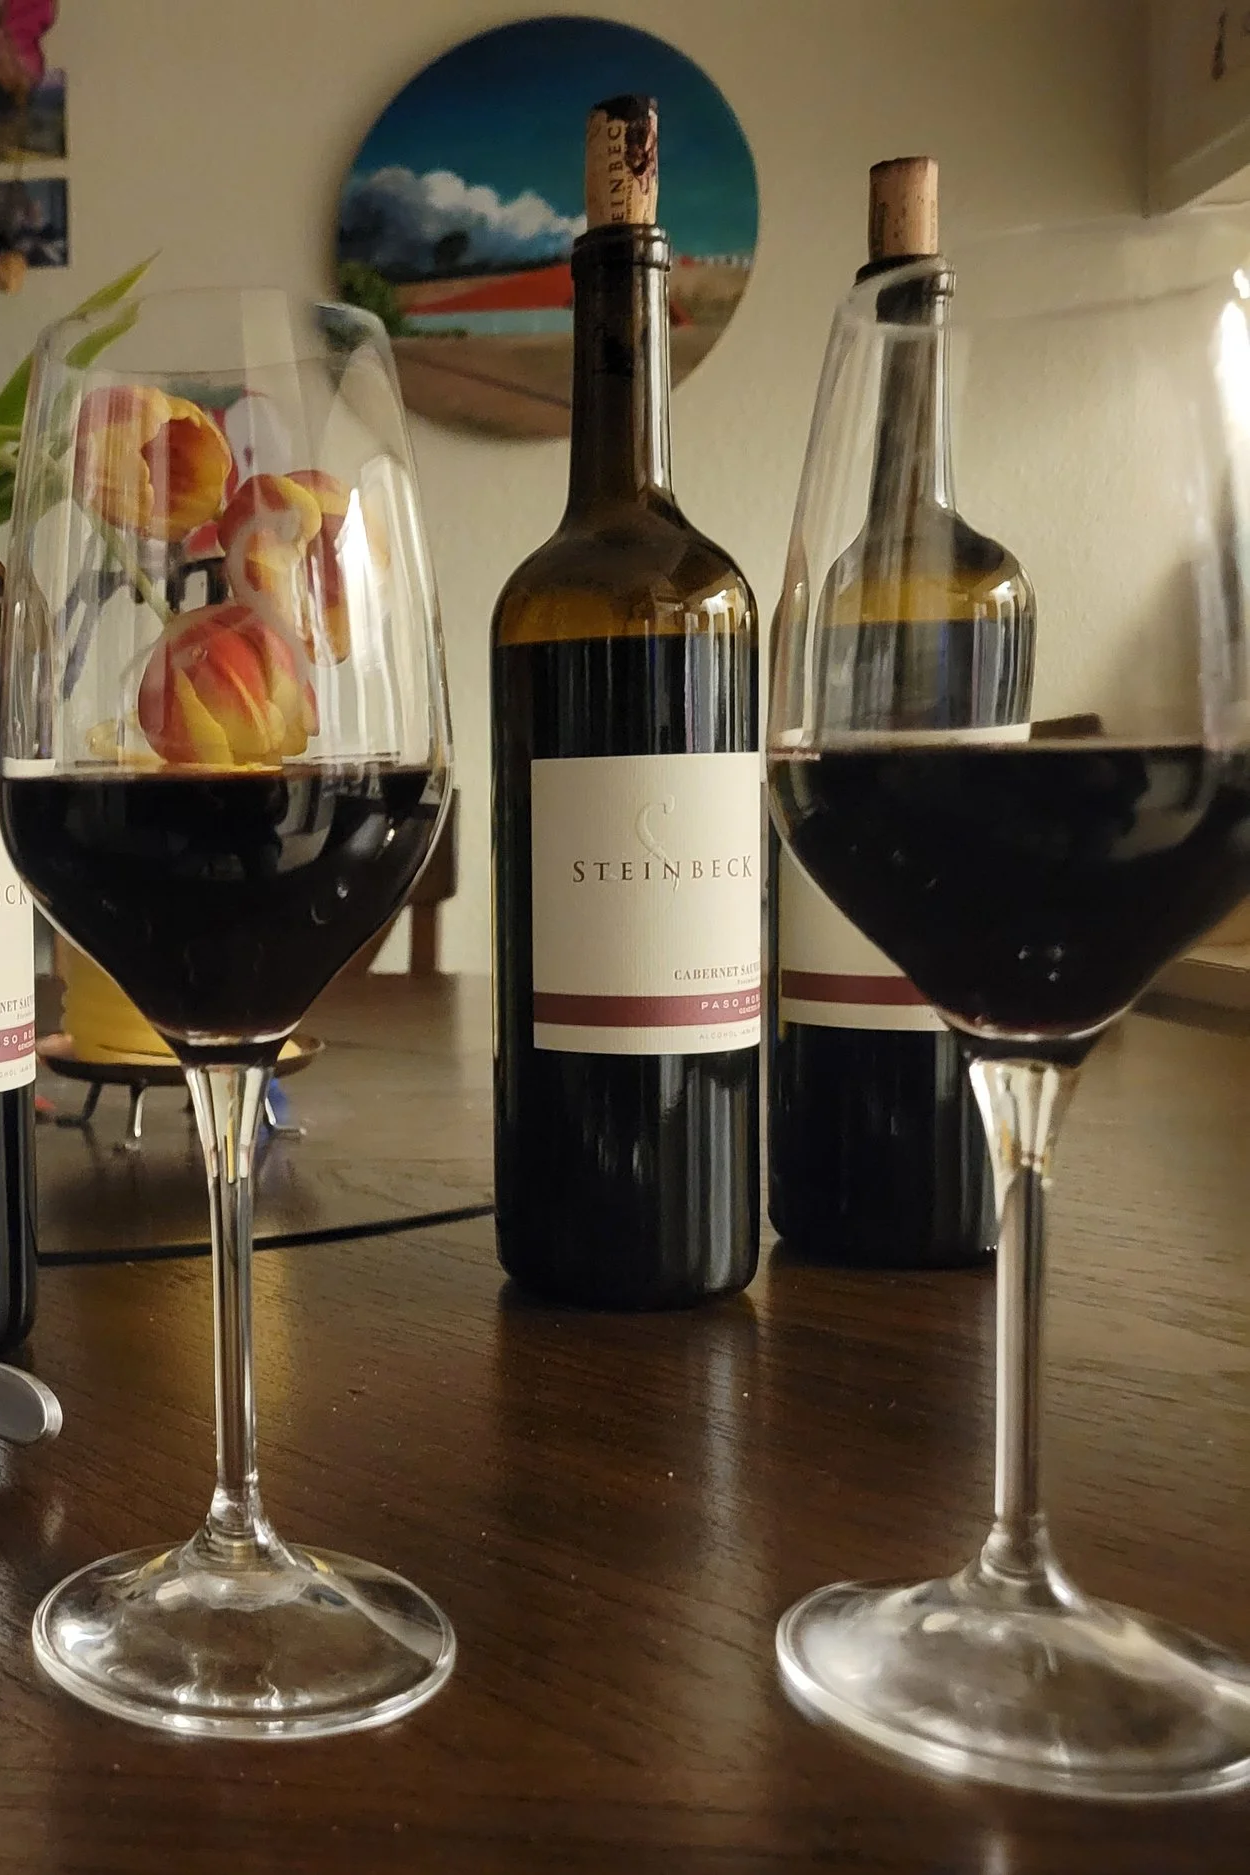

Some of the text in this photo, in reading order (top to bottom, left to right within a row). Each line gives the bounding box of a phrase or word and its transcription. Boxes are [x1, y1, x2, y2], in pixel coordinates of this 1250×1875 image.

[572, 855, 752, 883] STEINBECK
[674, 966, 738, 981] CABERNET
[701, 998, 739, 1010] PASO
